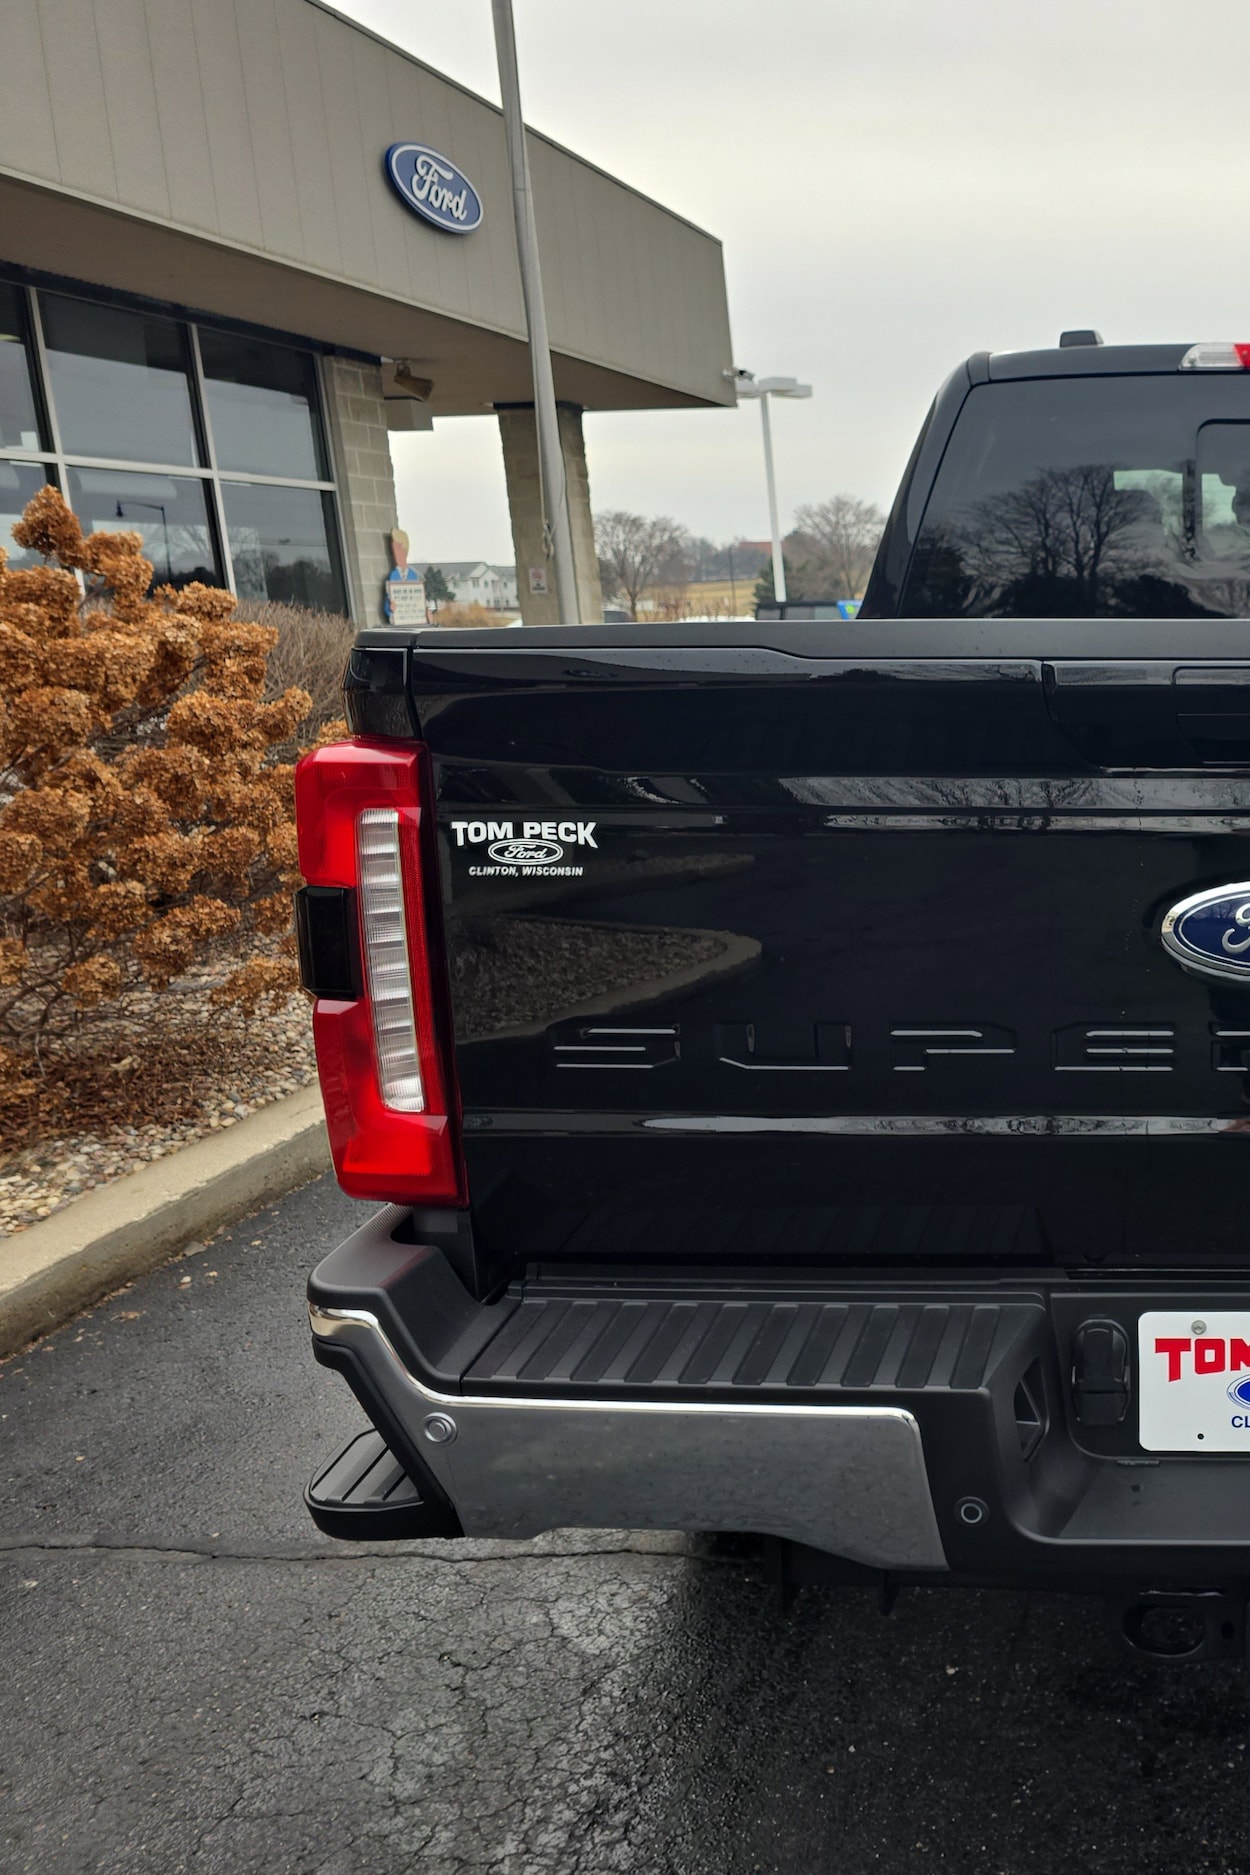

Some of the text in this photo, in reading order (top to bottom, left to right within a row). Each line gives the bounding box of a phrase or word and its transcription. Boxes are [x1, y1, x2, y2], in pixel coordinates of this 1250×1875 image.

[412, 155, 468, 221] Ford
[451, 821, 599, 849] TOM PECK
[504, 844, 547, 860] Ford
[468, 866, 584, 878] CLINTON, WISCONSIN
